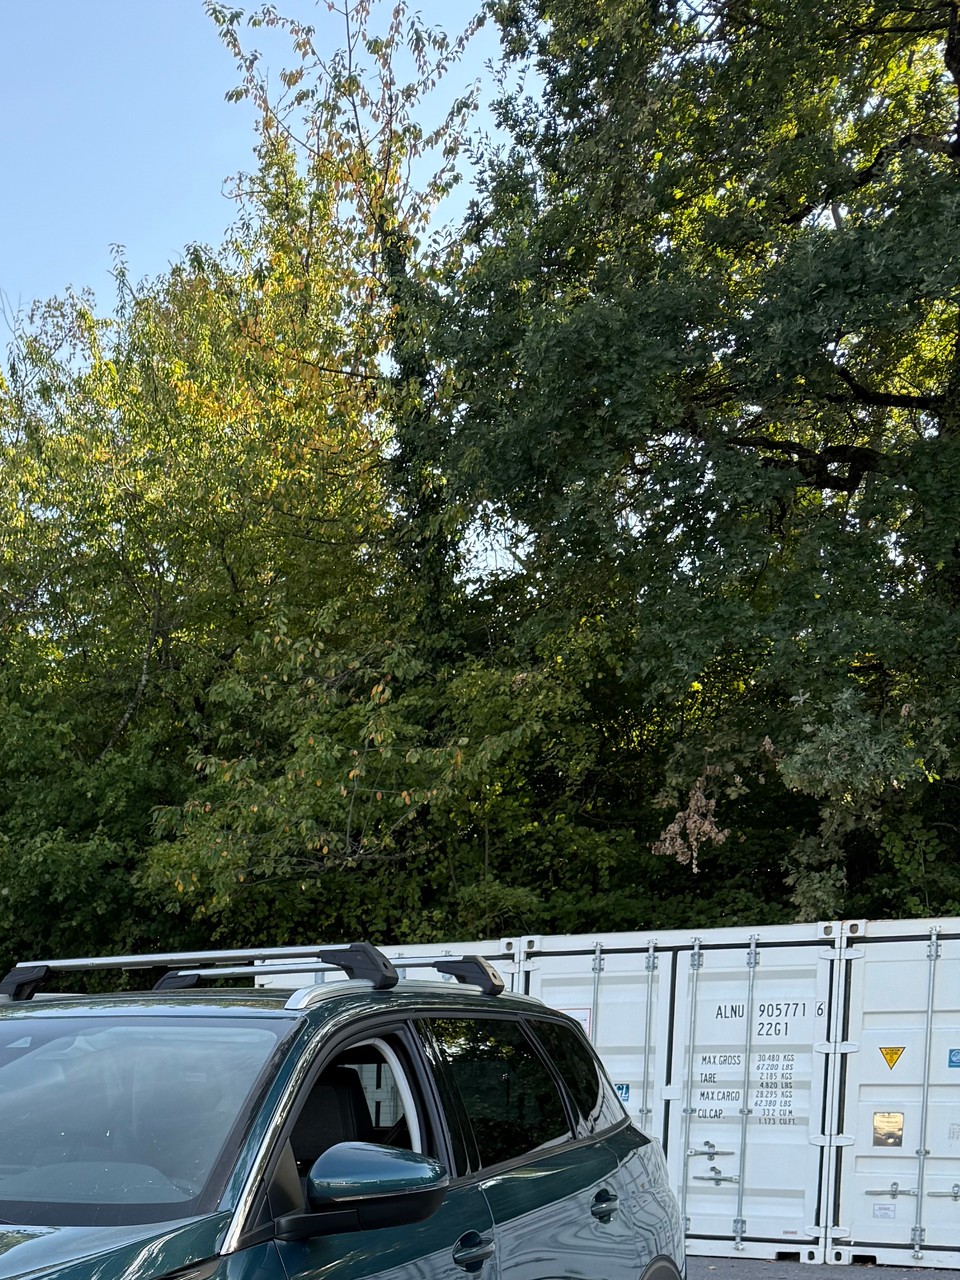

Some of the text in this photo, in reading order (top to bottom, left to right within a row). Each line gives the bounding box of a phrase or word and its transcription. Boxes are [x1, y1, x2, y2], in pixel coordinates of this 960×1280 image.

[715, 1002, 824, 1019] ALNU 905771 6
[757, 1022, 788, 1036] 22G1
[701, 1054, 795, 1066] MAX.GROSS 30.480 KGS
[756, 1063, 794, 1071] 67.200 LBS
[700, 1072, 793, 1083] TARE 2.185 KGS
[699, 1090, 740, 1101] MAX.CARGO
[781, 1090, 793, 1098] KGS
[758, 1118, 776, 1126] 1.173
